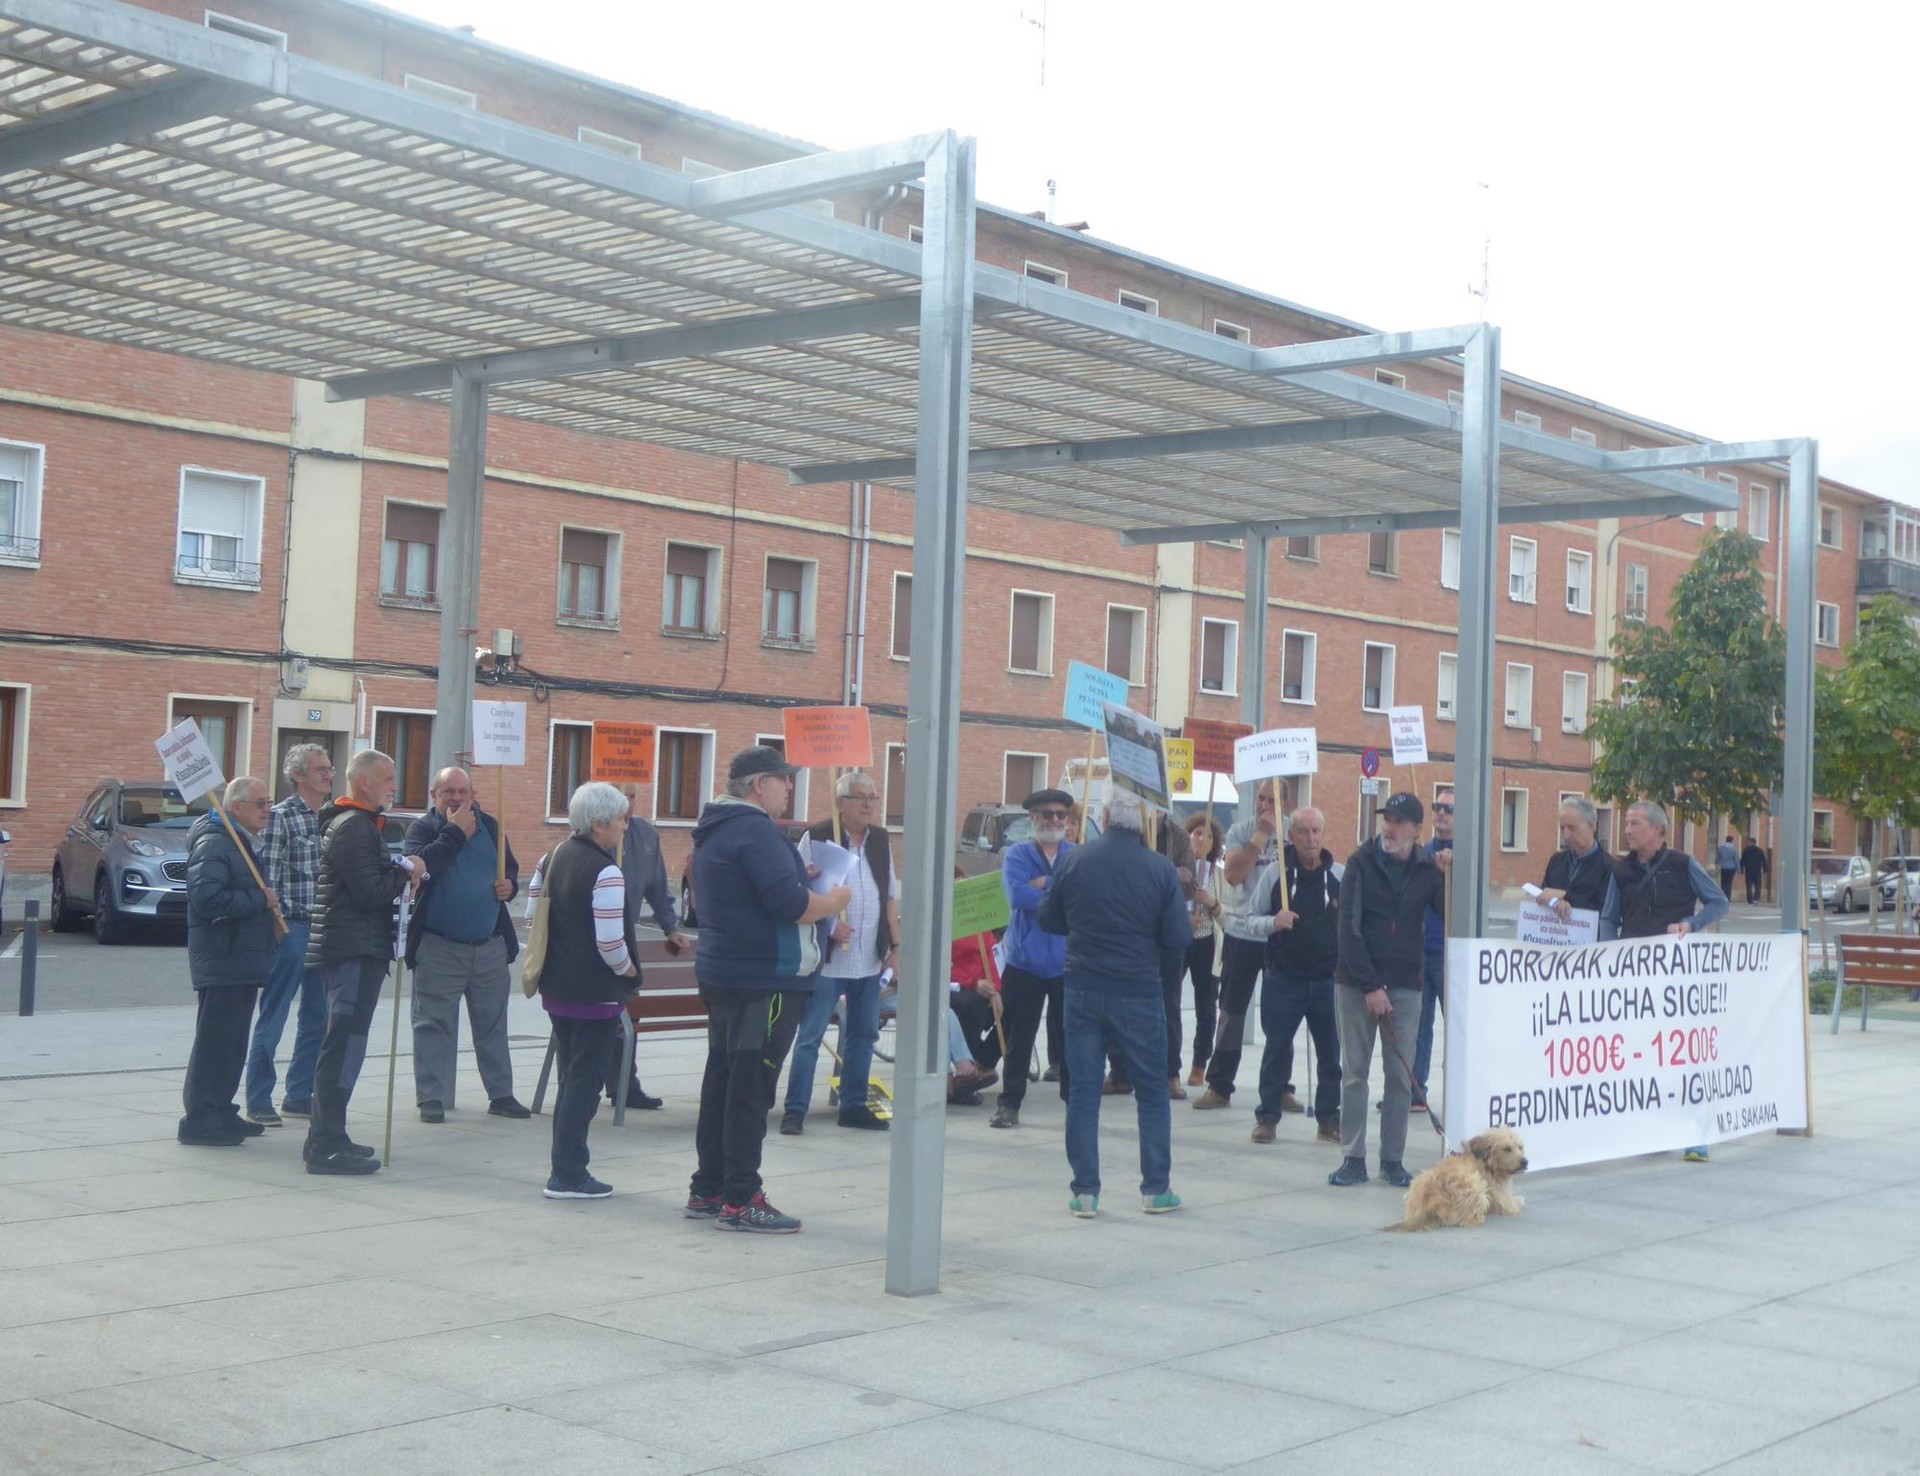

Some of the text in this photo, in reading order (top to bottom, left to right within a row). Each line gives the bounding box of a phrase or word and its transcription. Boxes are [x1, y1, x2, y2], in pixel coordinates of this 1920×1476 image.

[309, 710, 320, 720] 39
[616, 747, 632, 755] LAS
[1168, 747, 1188, 757] PAN
[1238, 736, 1308, 752] PENSION DUINA
[602, 758, 644, 767] PENSIONES
[1479, 942, 1771, 985] BORROKAK JARRAITZEN DU!!
[1532, 983, 1728, 1037] ¡¡LA LUCHA SIGUE!!
[1543, 1033, 1626, 1079] 1080€
[1651, 1025, 1719, 1068] 1200€
[1489, 1077, 1661, 1128] BERDINTASUNA
[1681, 1064, 1752, 1106] IGUALDAD
[1741, 1103, 1778, 1130] SAKANA
